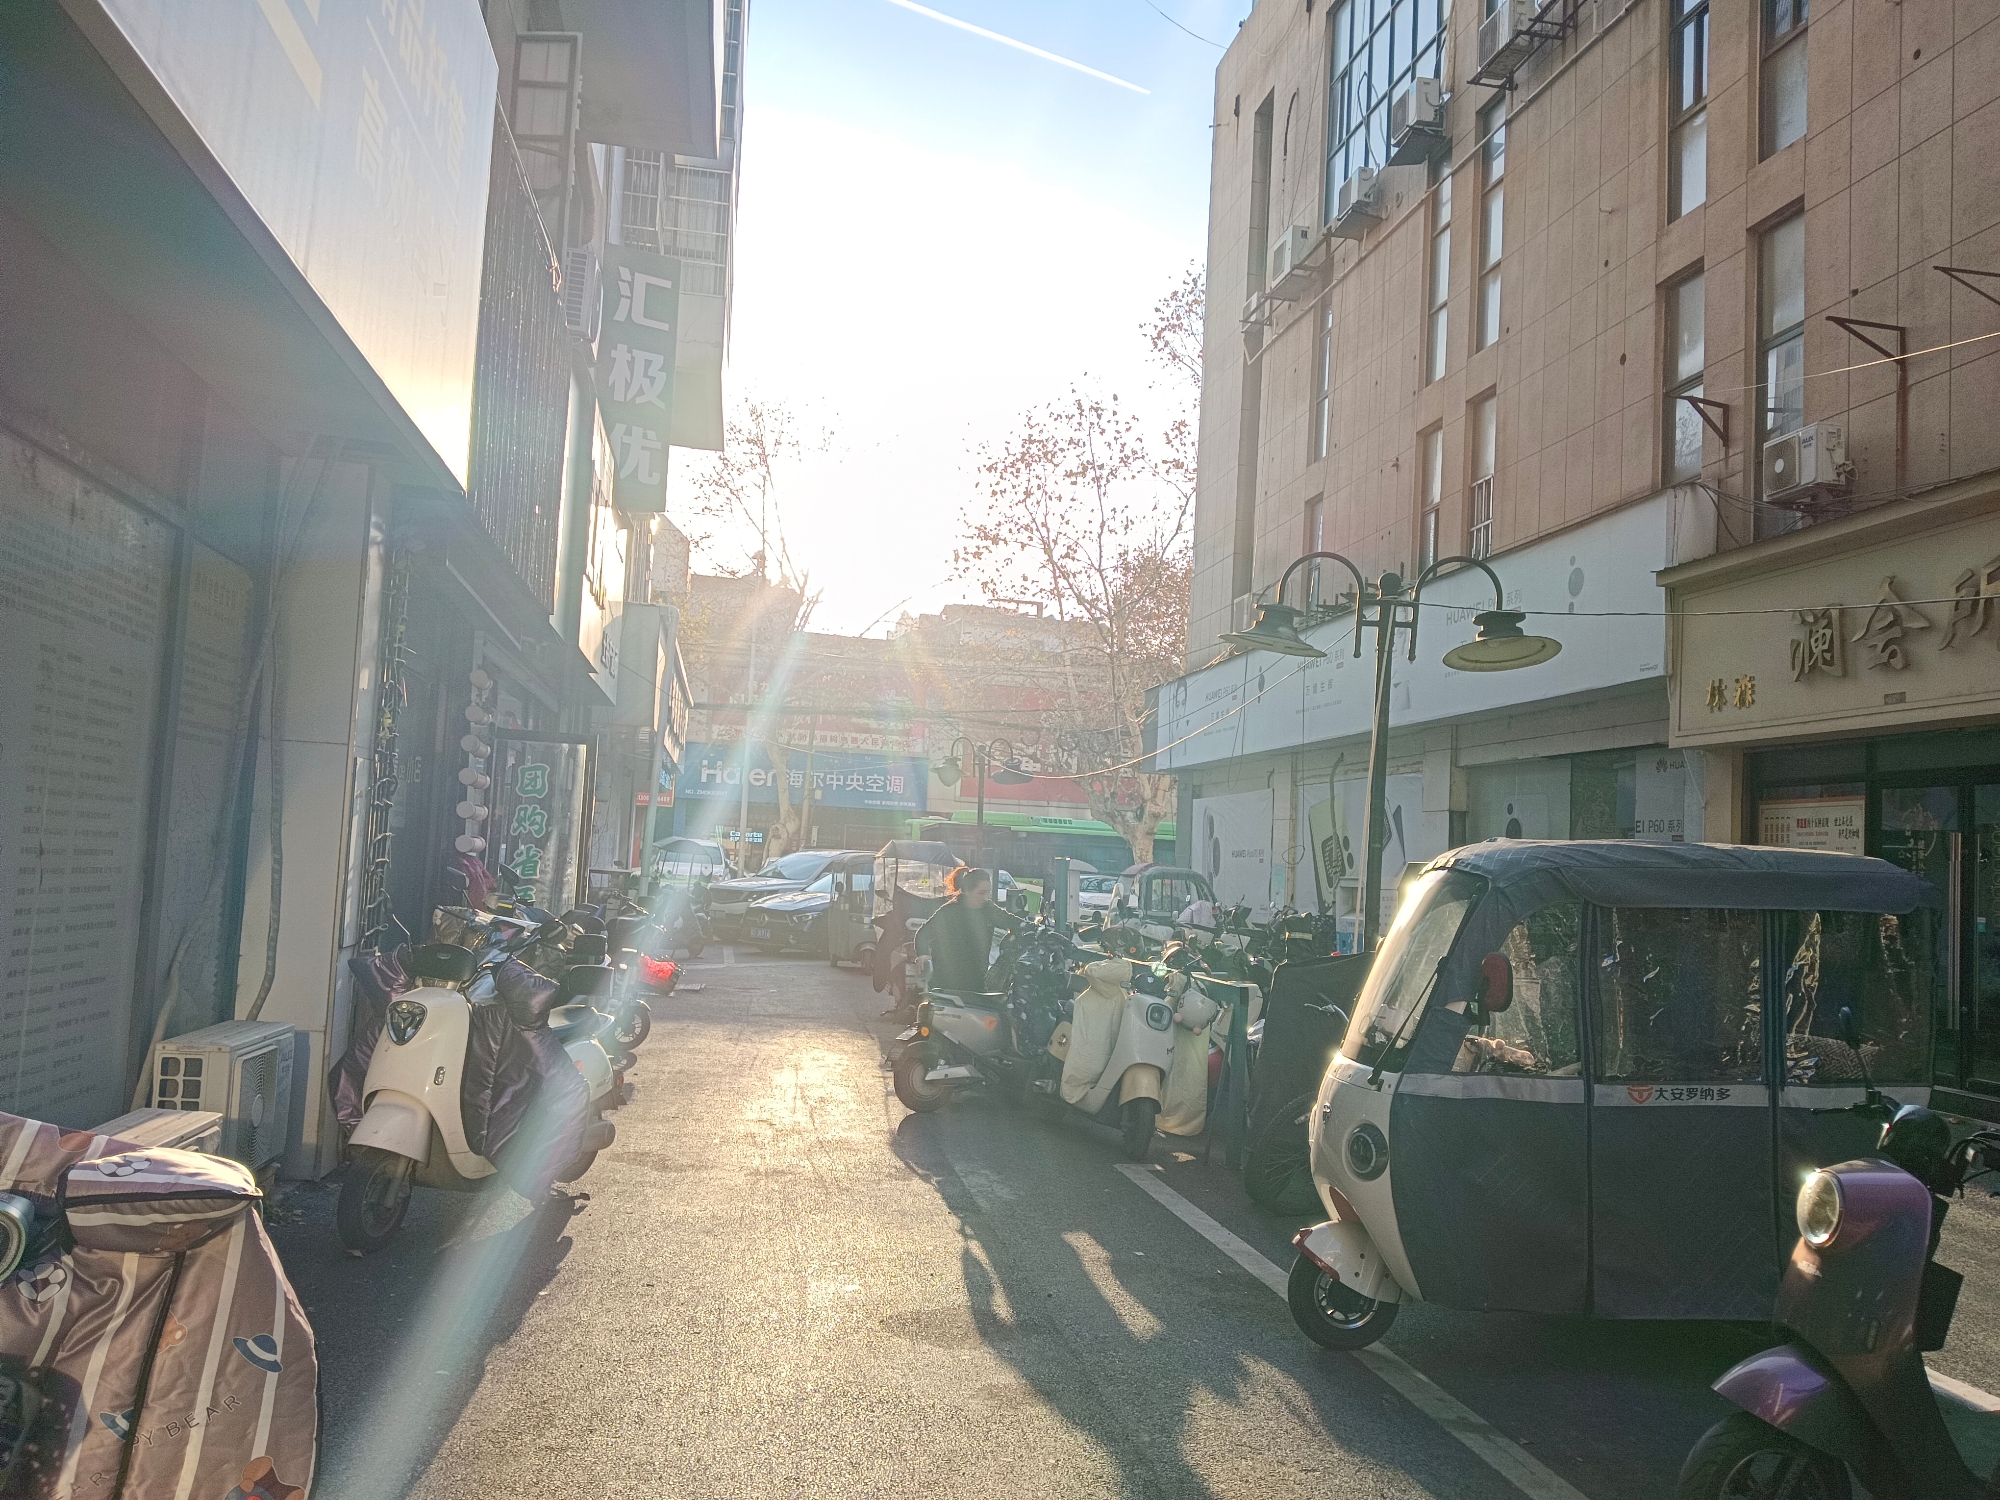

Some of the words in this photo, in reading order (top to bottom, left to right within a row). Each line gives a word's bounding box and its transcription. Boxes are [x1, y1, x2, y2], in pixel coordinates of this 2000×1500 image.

[608, 265, 673, 486] 汇极优
[1505, 588, 1523, 607] 系列
[701, 759, 777, 788] Haer
[1648, 819, 1665, 834] P60
[1667, 819, 1685, 833] 系列
[1654, 1086, 1731, 1101] 大安罗纳多
[165, 1394, 241, 1438] BEAR
